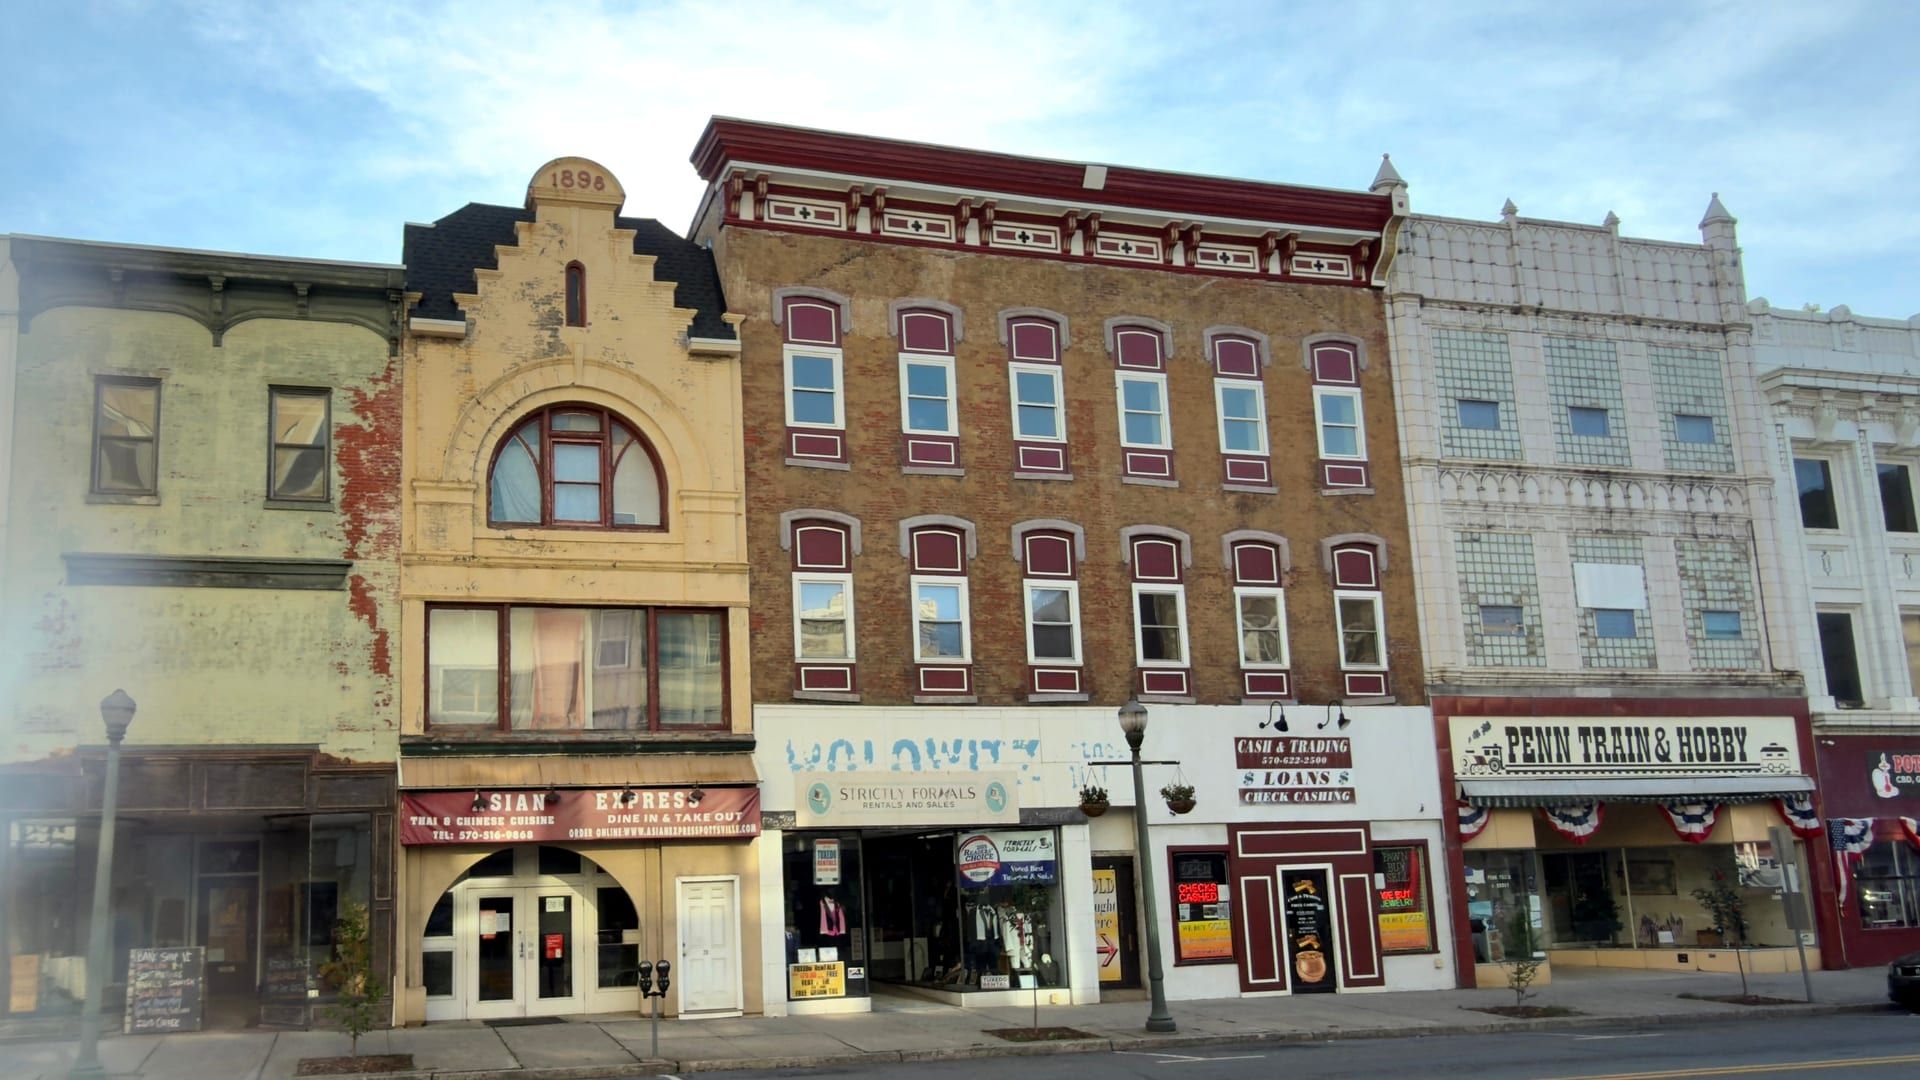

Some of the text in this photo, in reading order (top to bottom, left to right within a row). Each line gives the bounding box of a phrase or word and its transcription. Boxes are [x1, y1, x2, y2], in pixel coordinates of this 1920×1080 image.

[1238, 740, 1349, 753] CASH & TRADING
[1505, 726, 1748, 763] PENN TRAIN & HOBBY
[1264, 771, 1331, 785] LOANS
[840, 786, 976, 801] STRICTLY FORMALS
[1245, 791, 1351, 802] CHECK CASHING
[410, 816, 438, 826] THAI
[456, 817, 504, 826] CHINESE
[510, 816, 554, 825] CUISINE
[607, 812, 743, 824] DINE IN & TAKE OUT
[433, 831, 454, 840] TEL:
[569, 827, 593, 838] ORDER
[965, 853, 994, 863] CHOICE
[1178, 883, 1217, 893] CHECKS
[1179, 893, 1218, 903] CASHED
[1381, 899, 1413, 908] JEWELRY
